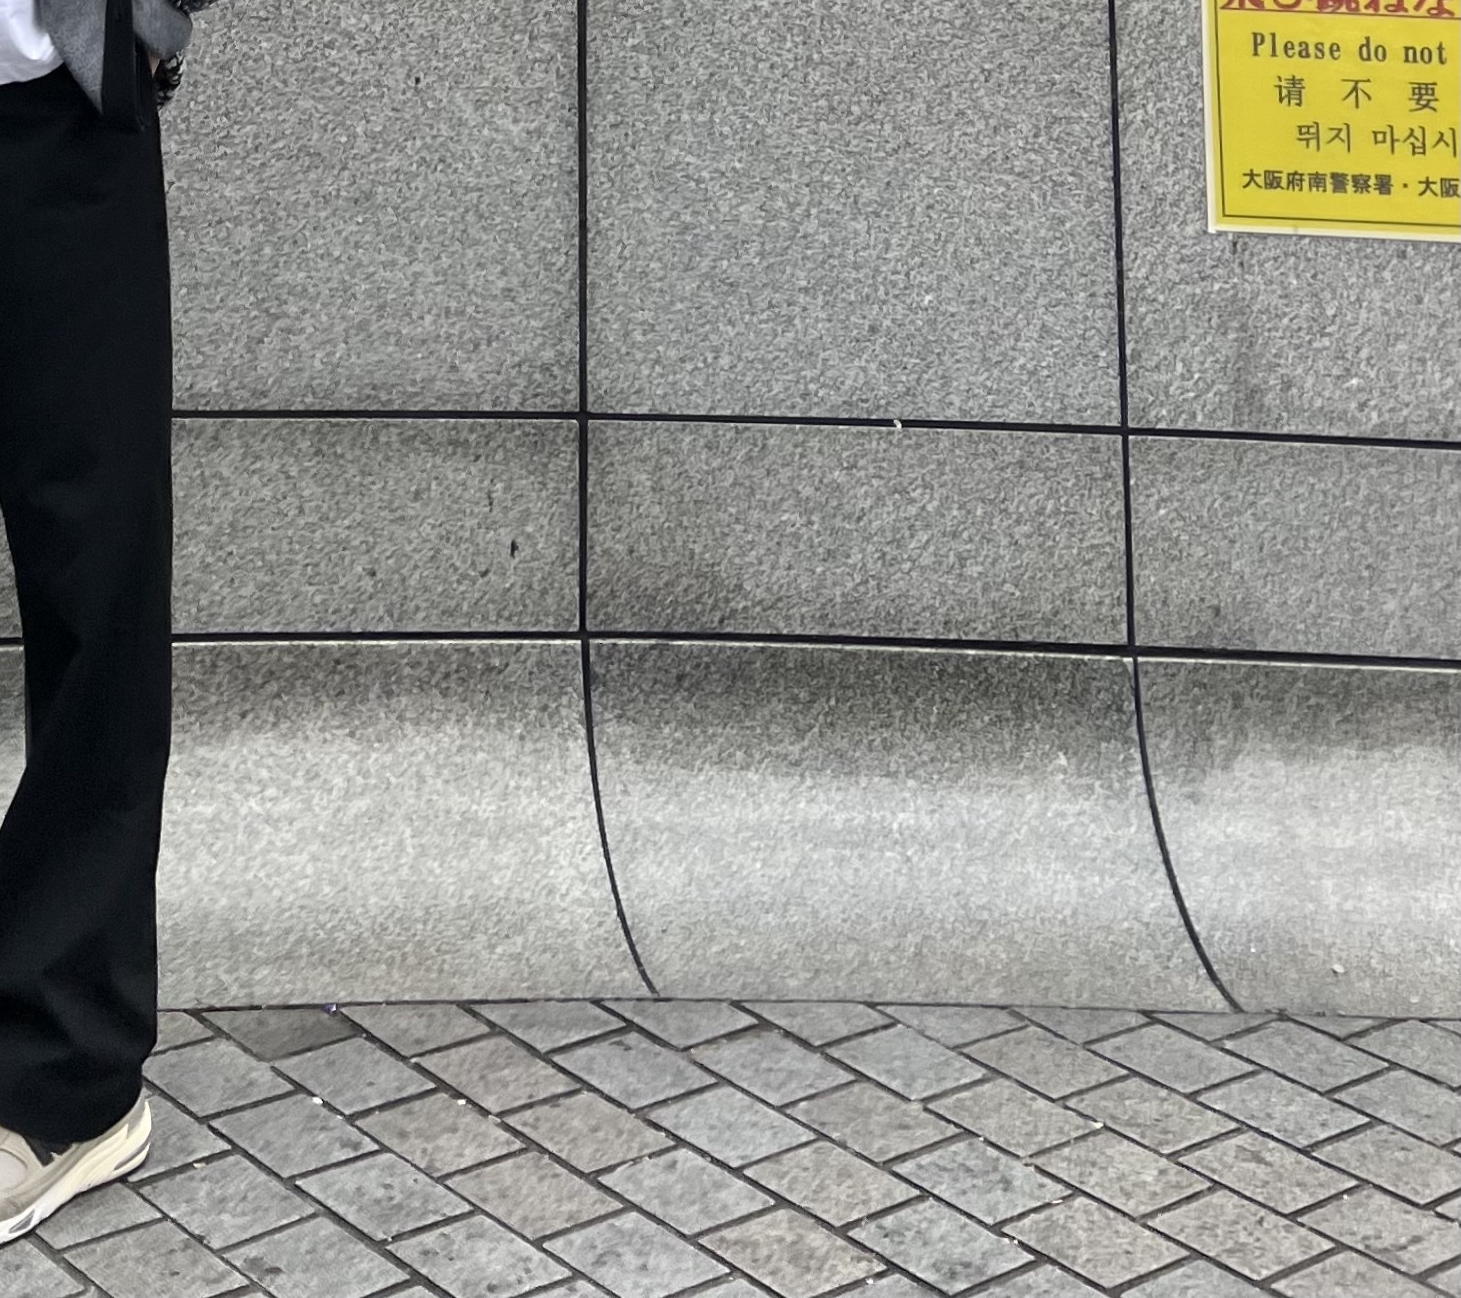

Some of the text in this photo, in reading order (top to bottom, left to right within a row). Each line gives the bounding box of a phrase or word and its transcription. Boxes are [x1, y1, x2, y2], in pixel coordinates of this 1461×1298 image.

[1251, 31, 1448, 65] Please do not
[1296, 121, 1459, 158] 뛰지 마십시
